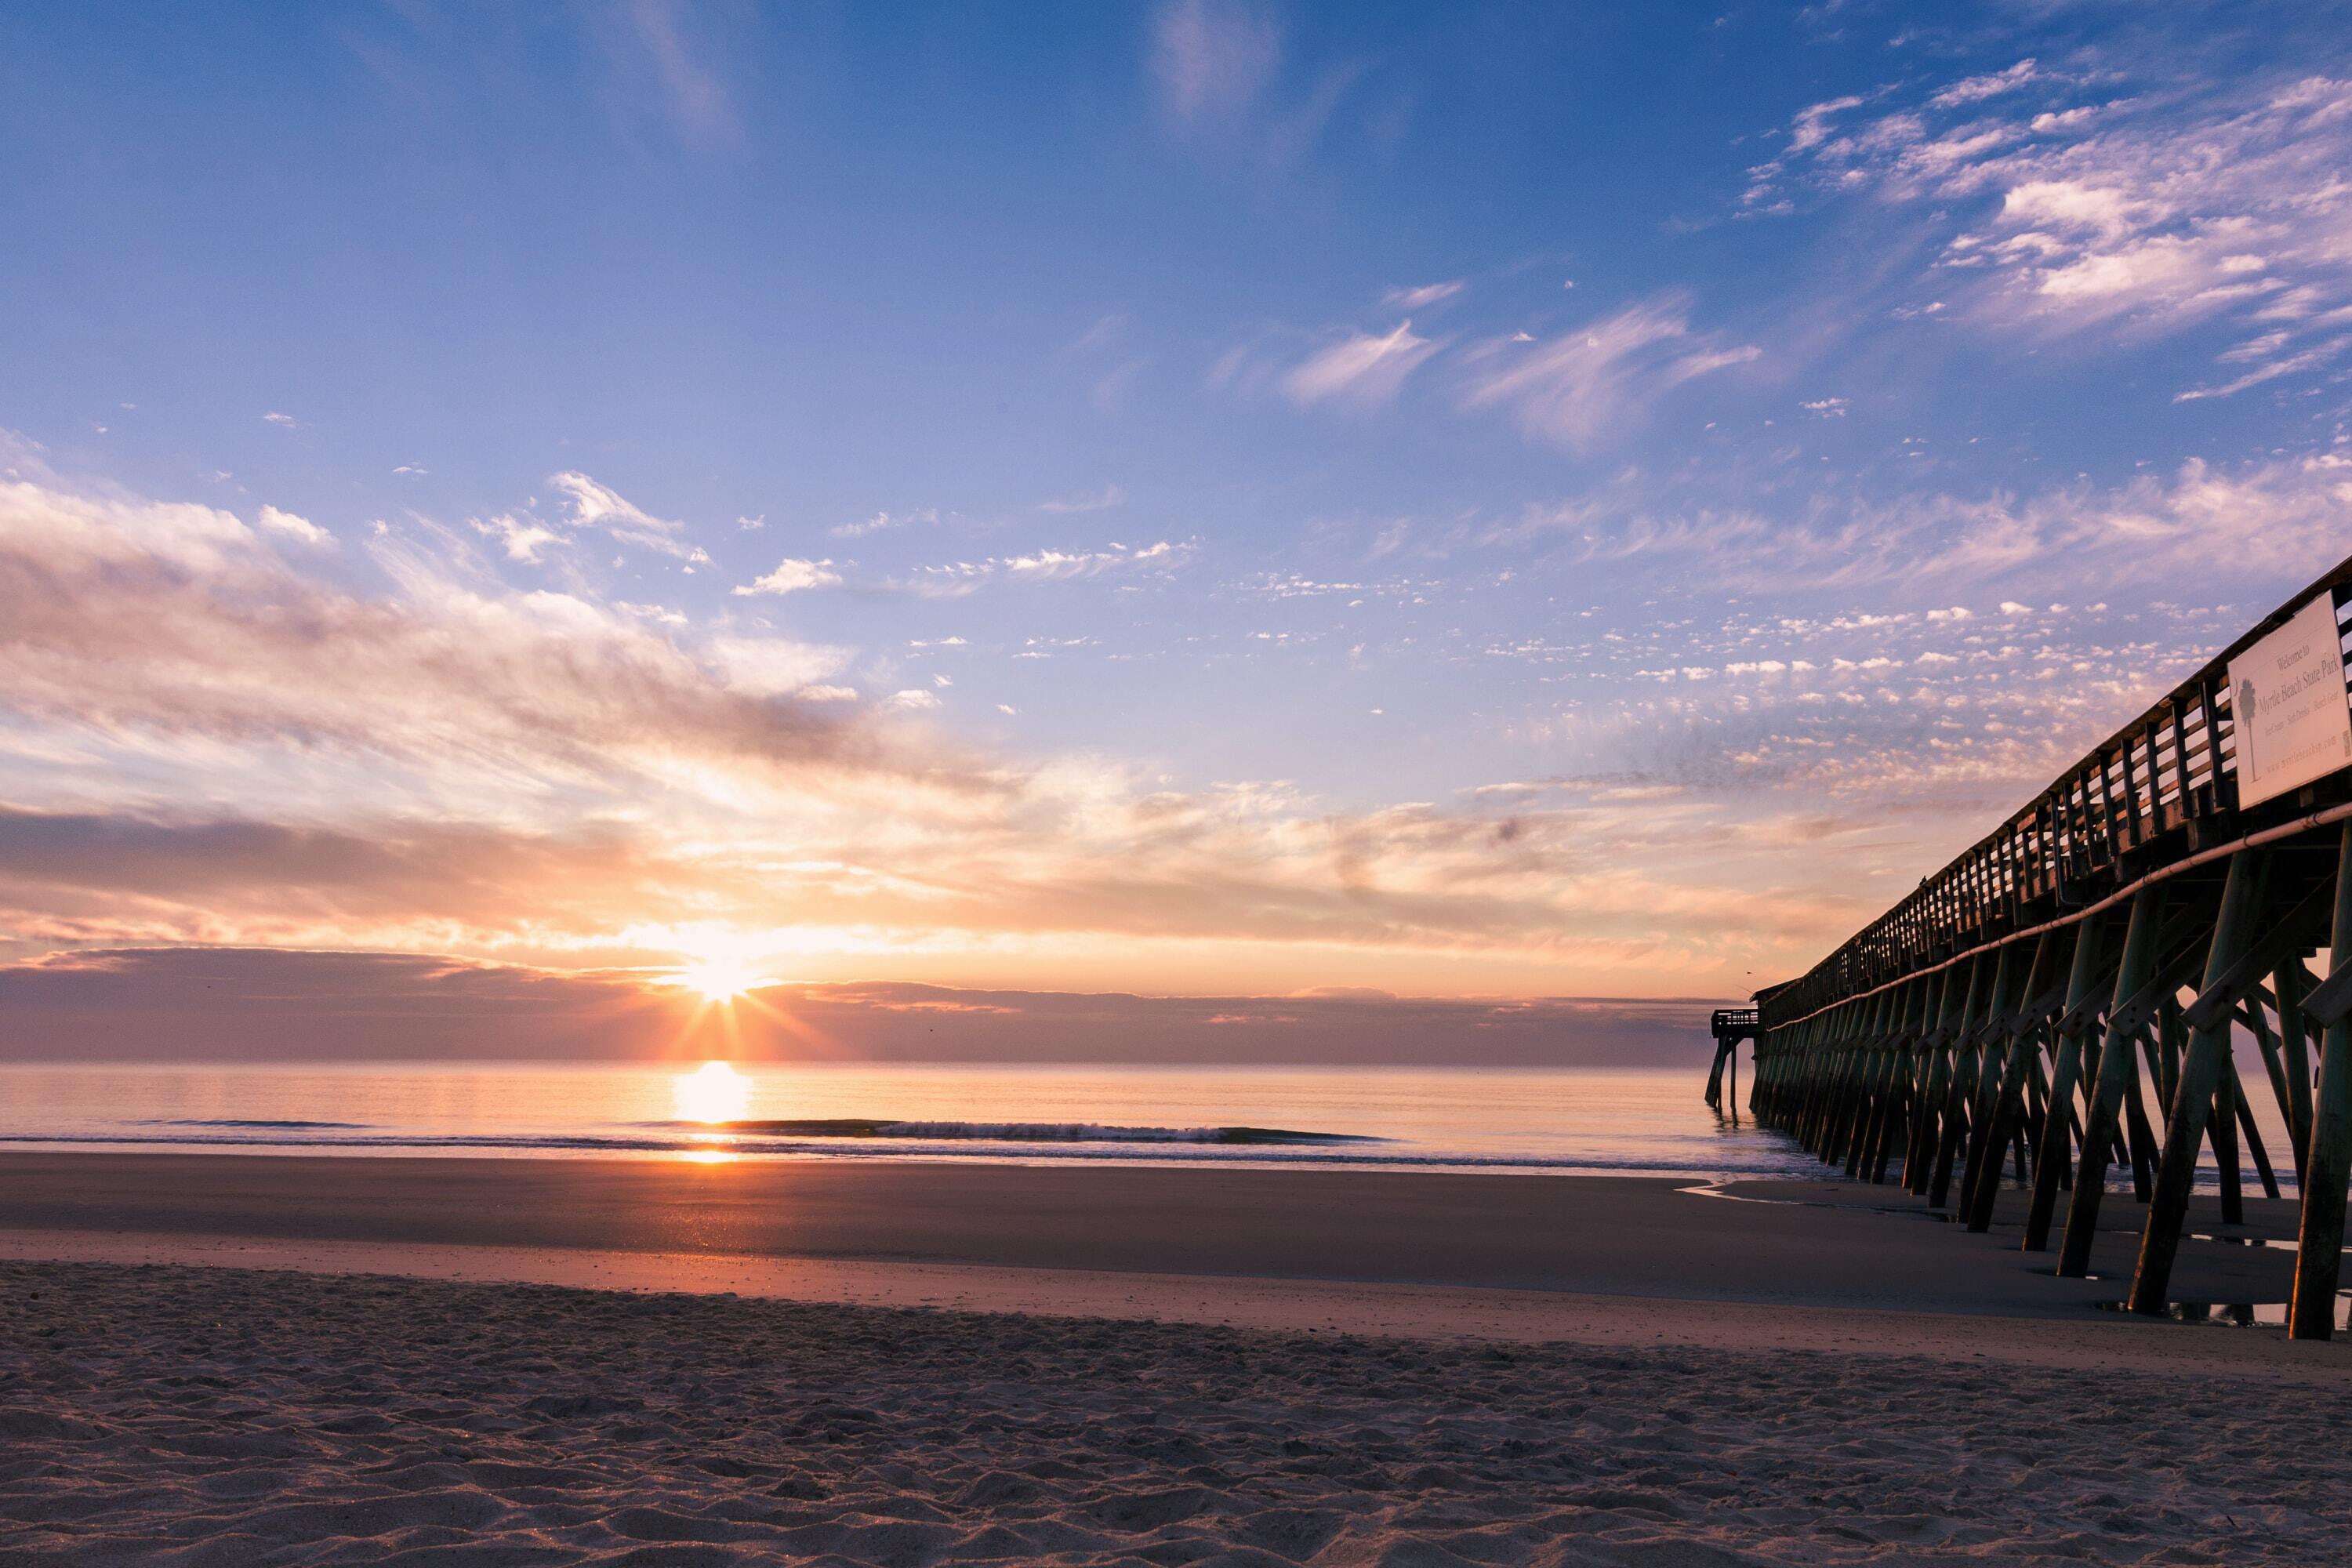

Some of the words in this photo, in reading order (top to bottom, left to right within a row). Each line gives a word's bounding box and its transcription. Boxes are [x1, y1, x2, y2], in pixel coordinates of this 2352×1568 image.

[2277, 649, 2303, 672] Welcome
[2303, 644, 2310, 657] to
[2259, 690, 2281, 715] Myrtle
[2281, 676, 2303, 702] Beach
[2302, 669, 2321, 688] State
[2321, 652, 2339, 678] Park
